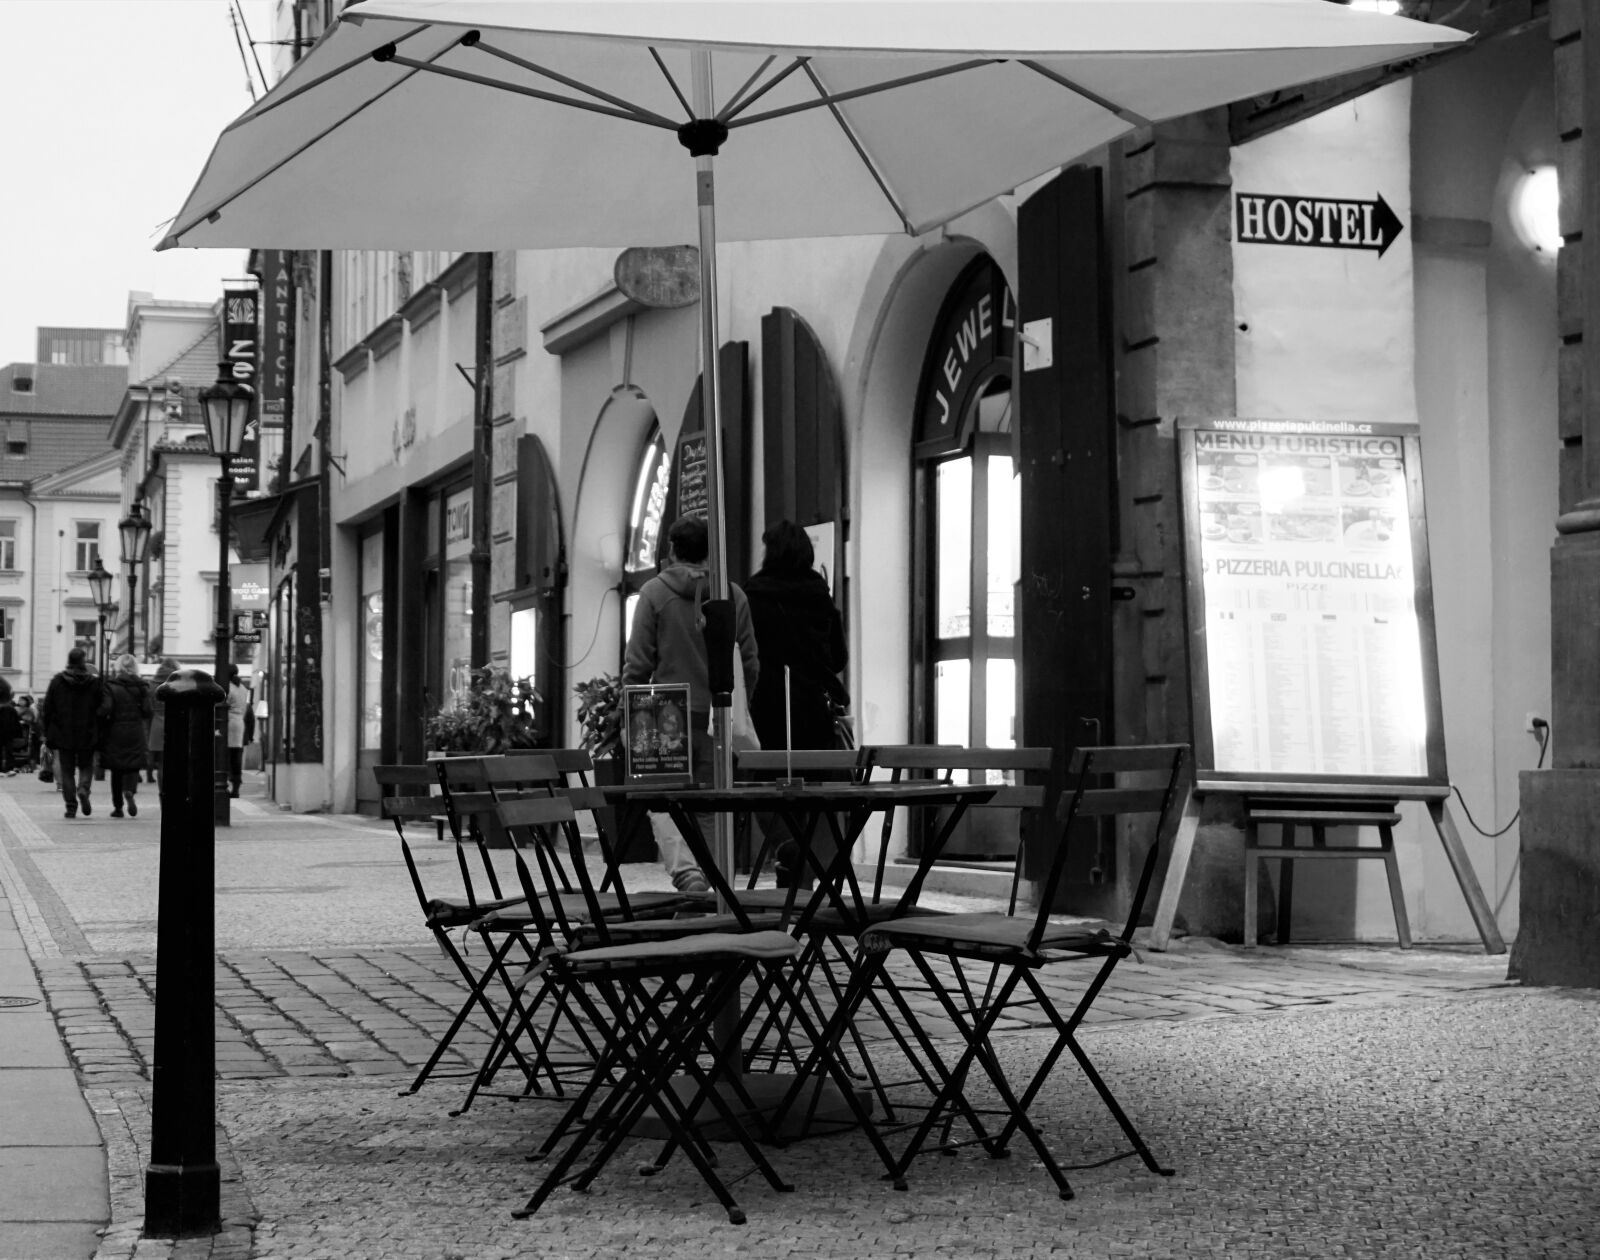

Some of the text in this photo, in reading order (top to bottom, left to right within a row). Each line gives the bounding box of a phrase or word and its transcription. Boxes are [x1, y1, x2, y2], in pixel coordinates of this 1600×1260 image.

[1240, 197, 1383, 247] HOSTEL
[1213, 419, 1373, 434] www.pizzeriapulcinella.cz
[1195, 432, 1398, 456] MENU TURISTICO
[1216, 558, 1397, 580] PIZZERIA PULCINELLA
